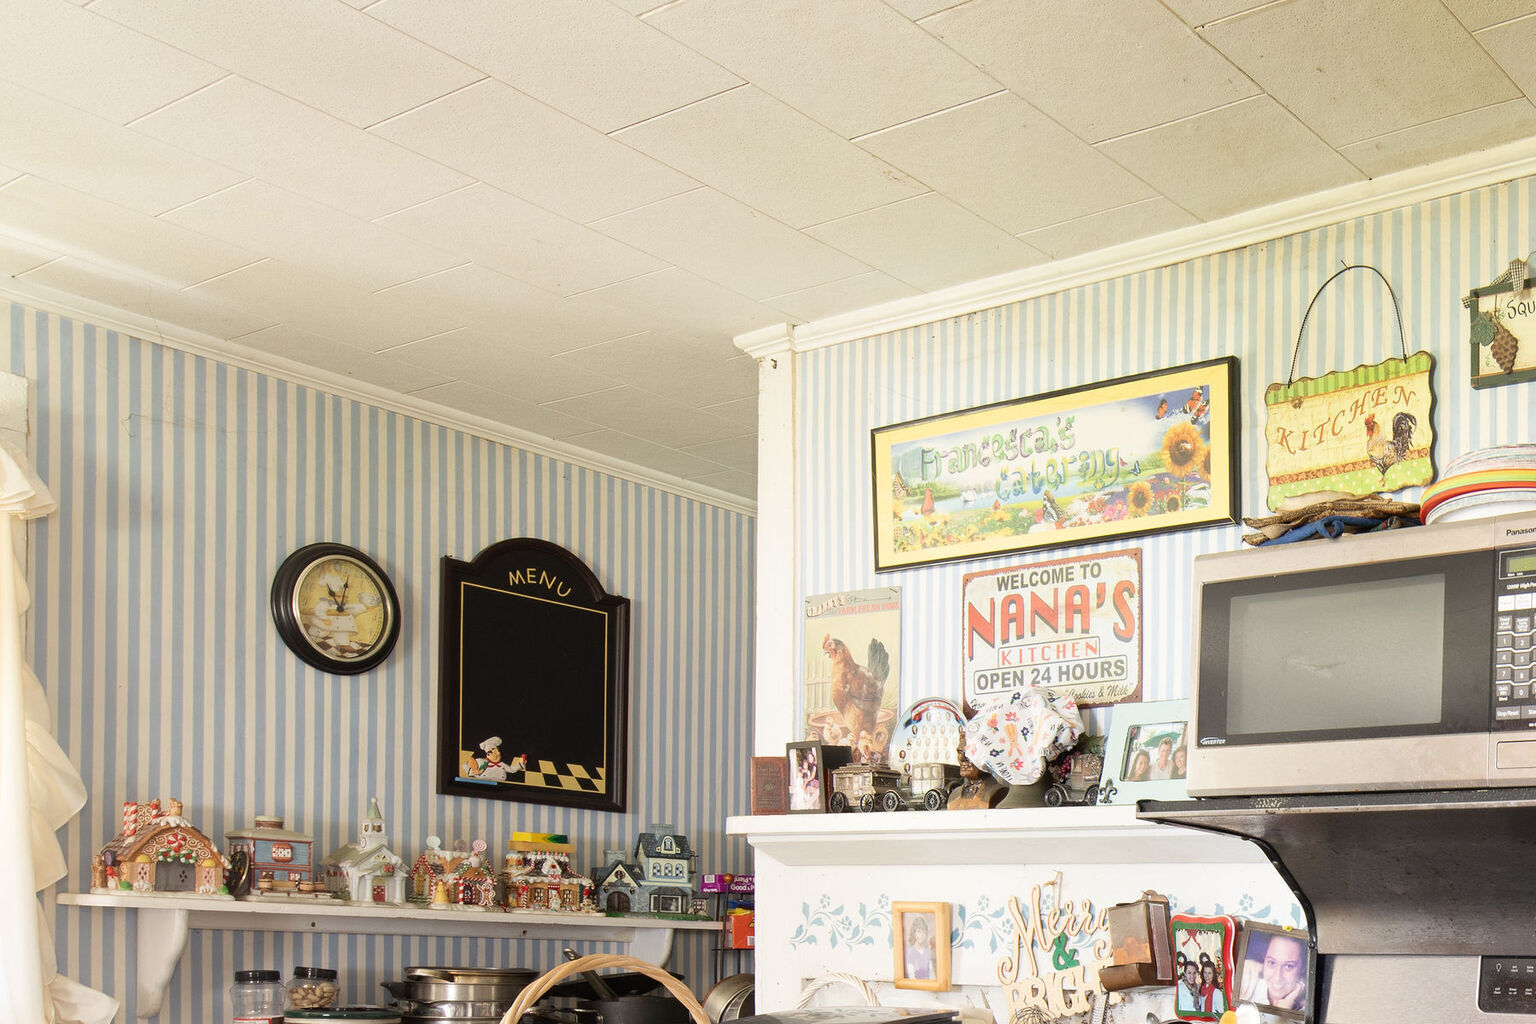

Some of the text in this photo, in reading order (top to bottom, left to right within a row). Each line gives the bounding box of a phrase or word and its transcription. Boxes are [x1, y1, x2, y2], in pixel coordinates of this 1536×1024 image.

[1276, 385, 1416, 455] KITCHEN
[508, 567, 572, 597] MENU
[996, 561, 1102, 592] WELCOME TO
[968, 580, 1136, 662] NANA'S
[1001, 639, 1098, 666] KITCHEN
[976, 659, 1126, 690] OPEN 24 HOURS
[1051, 931, 1080, 972] &
[1003, 960, 1122, 1021] BRIGH
